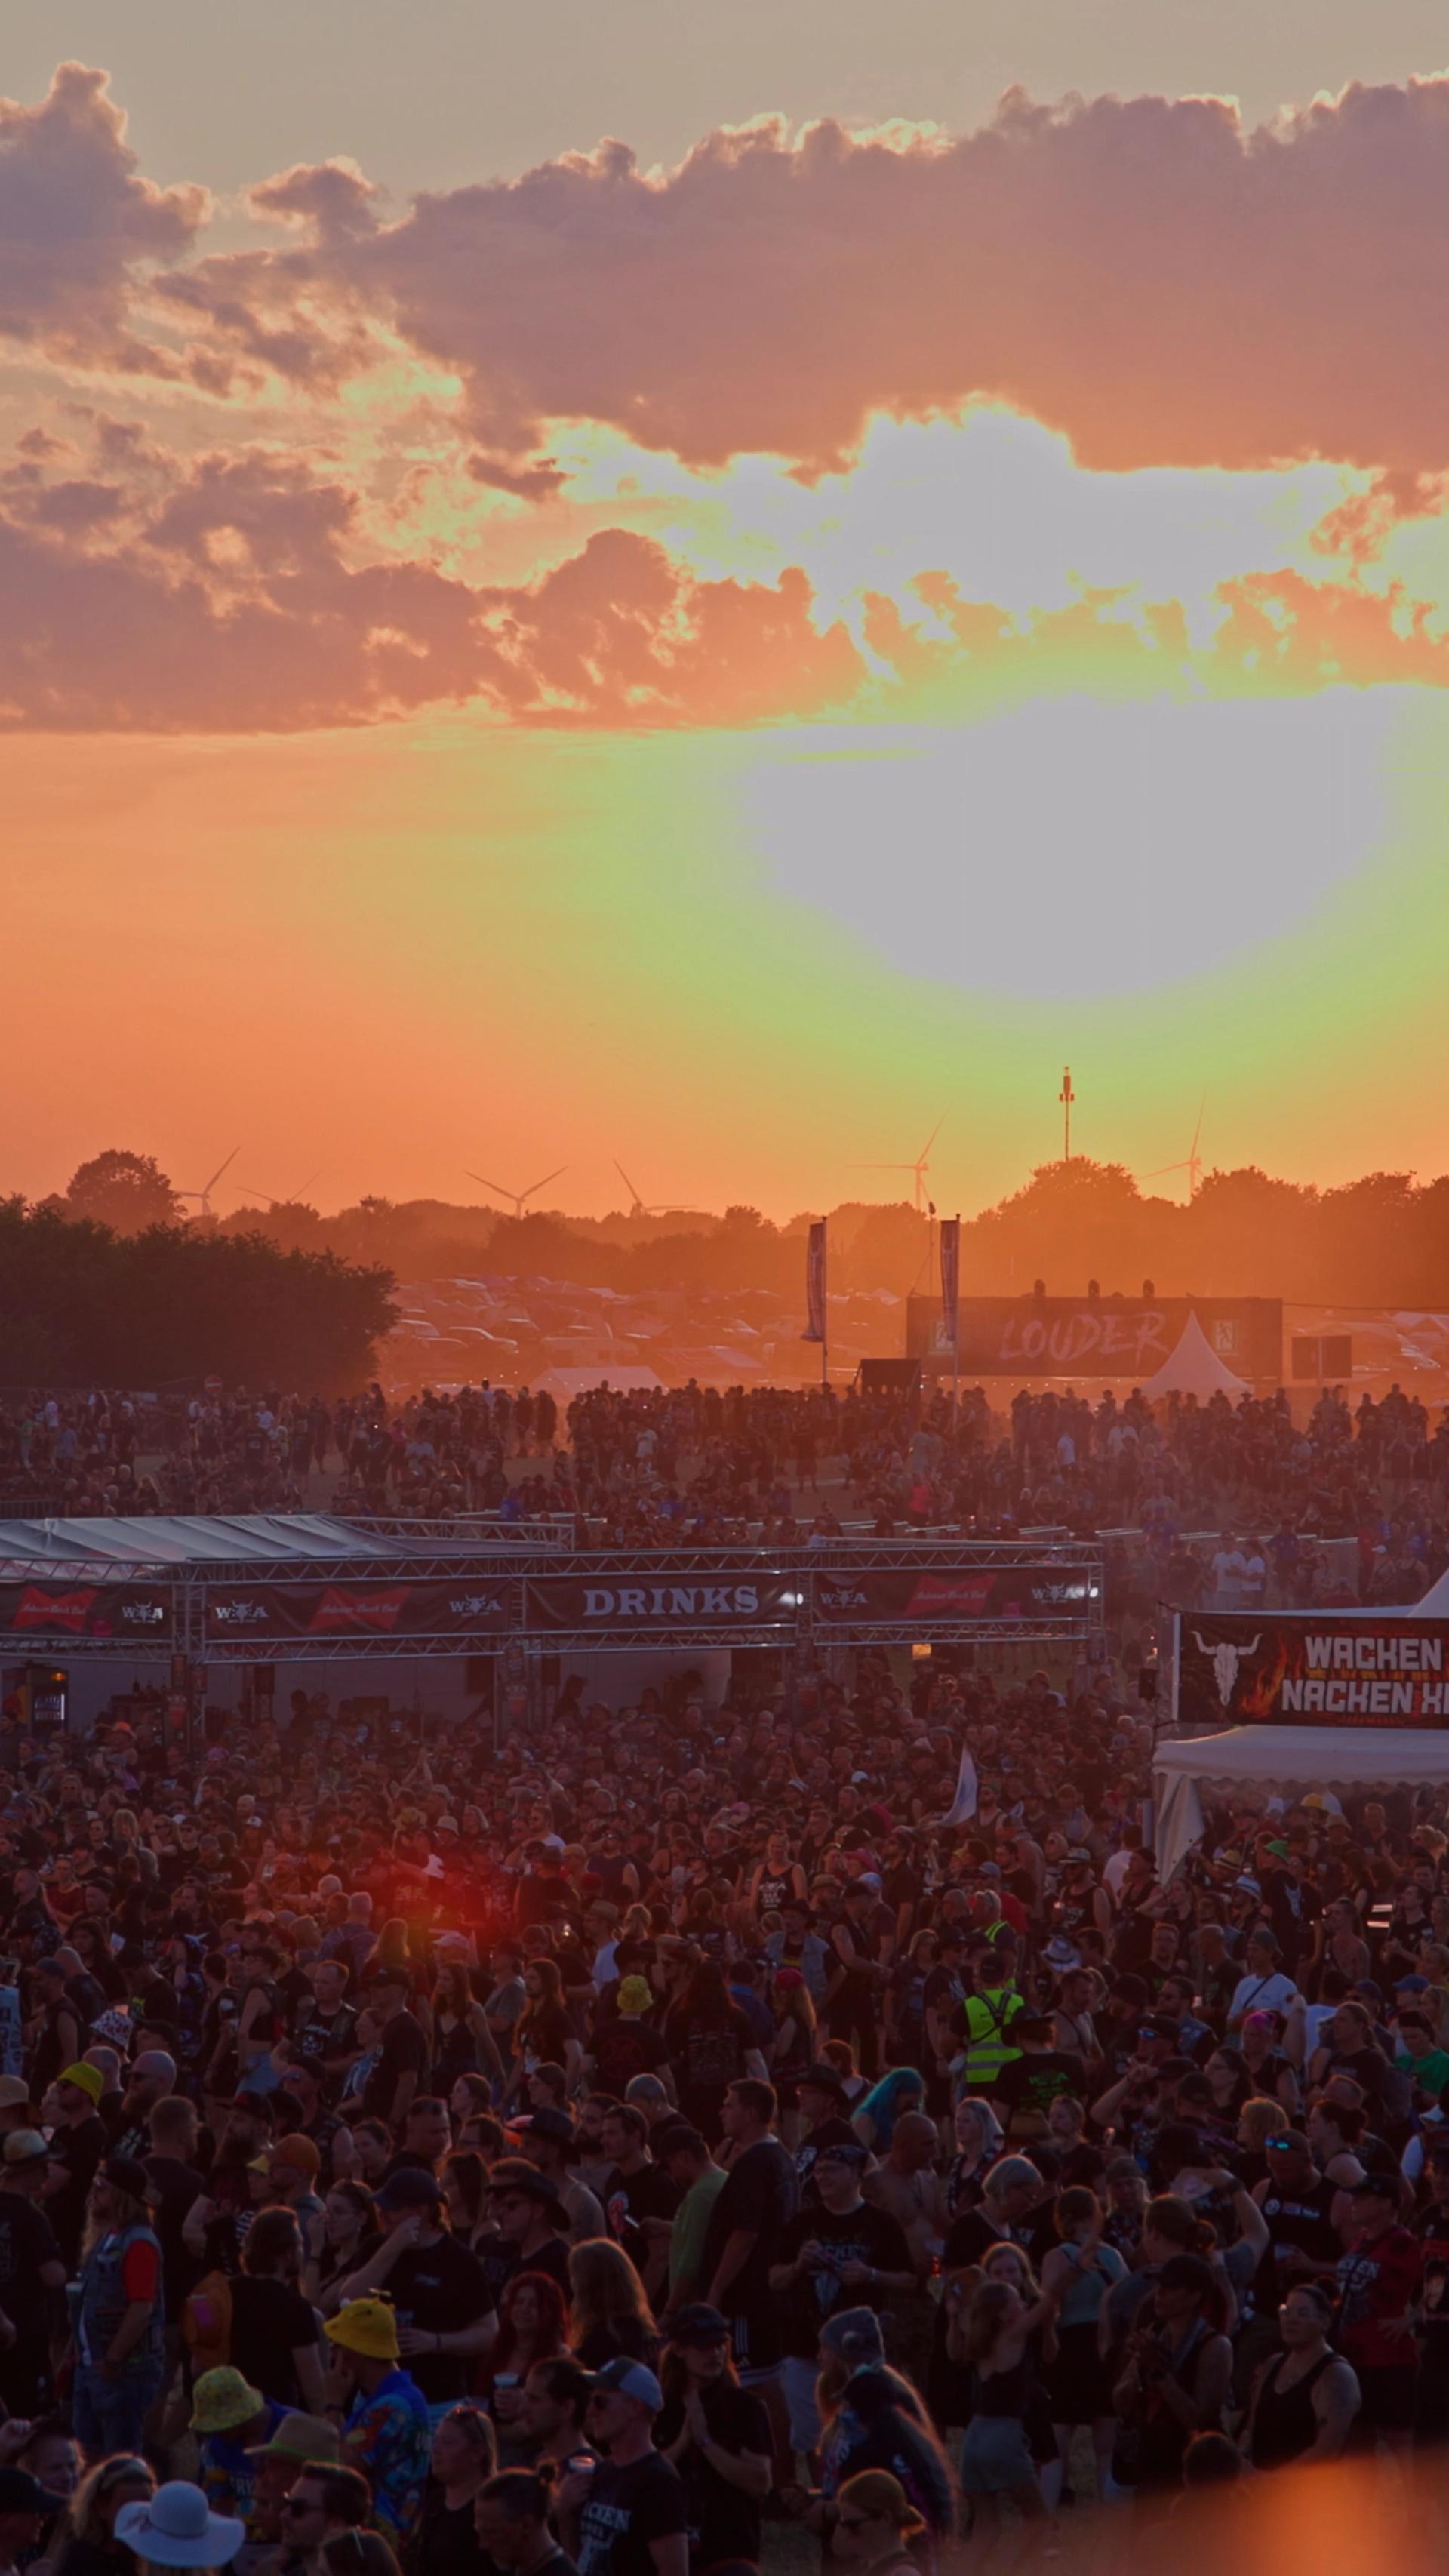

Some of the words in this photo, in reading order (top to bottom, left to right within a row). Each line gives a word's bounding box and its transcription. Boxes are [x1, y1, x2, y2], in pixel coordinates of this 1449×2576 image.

[999, 1311, 1171, 1373] LOUDER
[583, 1585, 758, 1616] DRINKS
[1304, 1636, 1442, 1670] WACKEN
[1281, 1679, 1414, 1713] NACKEN
